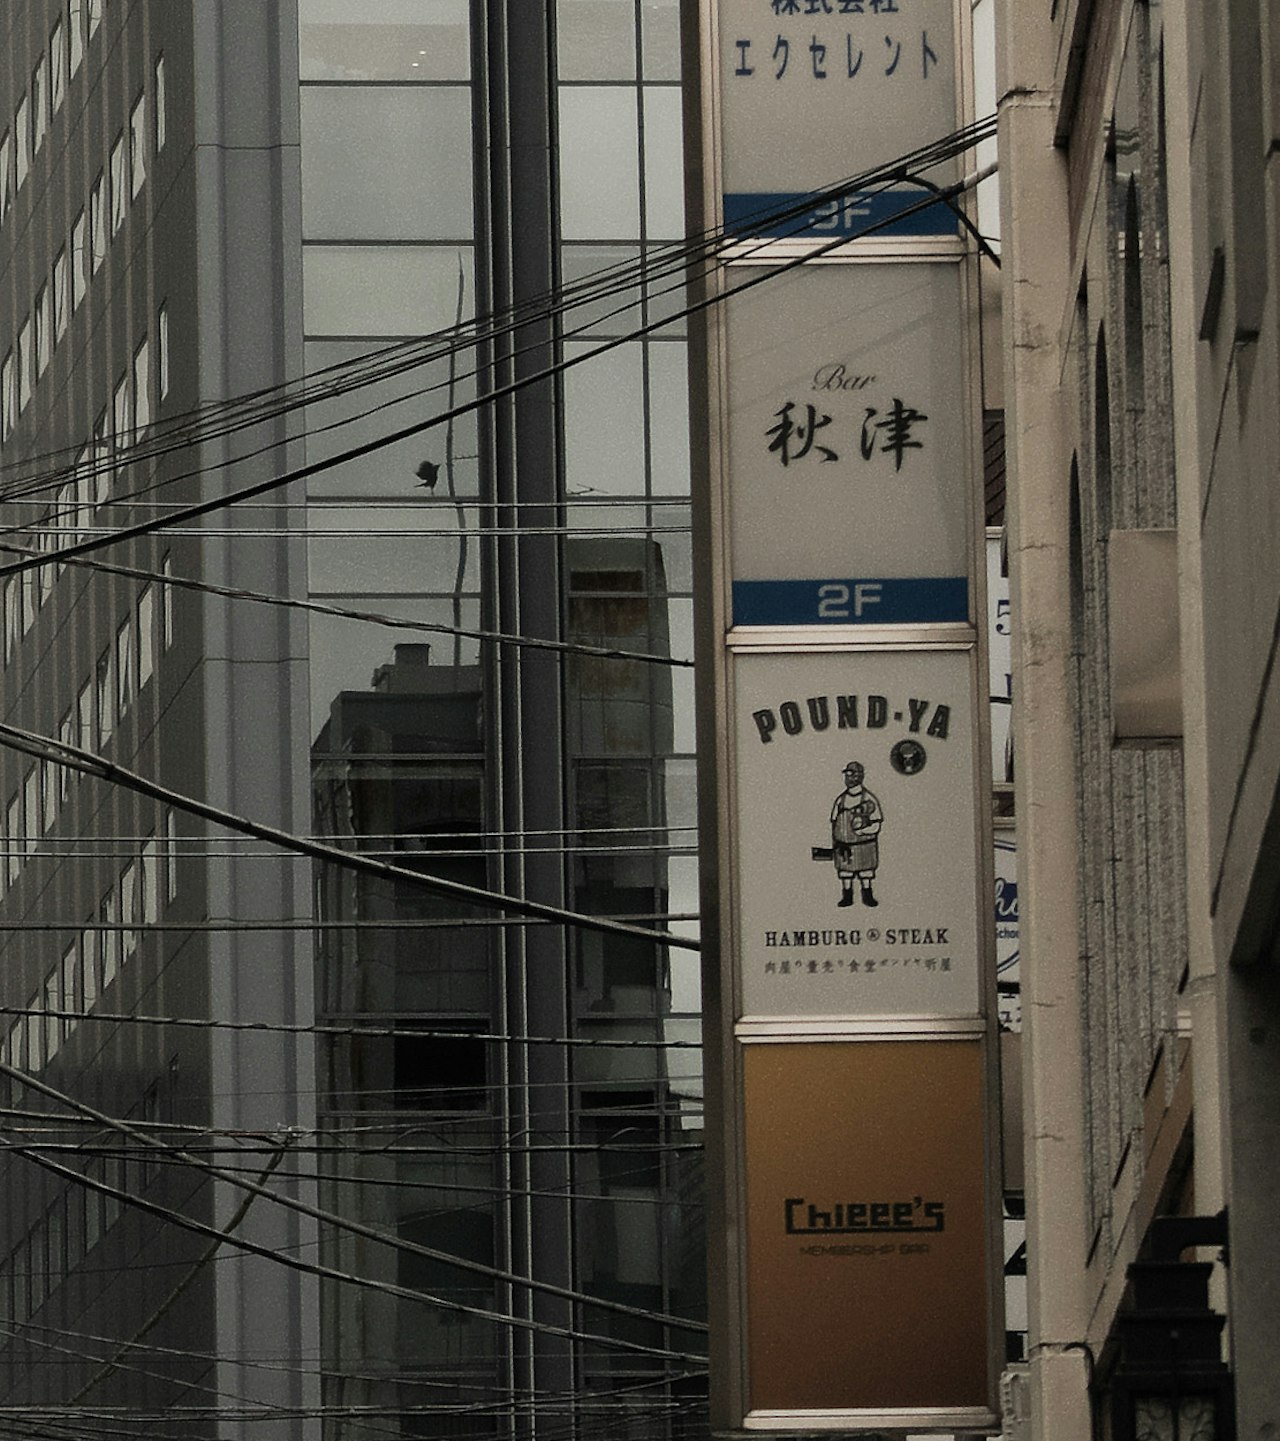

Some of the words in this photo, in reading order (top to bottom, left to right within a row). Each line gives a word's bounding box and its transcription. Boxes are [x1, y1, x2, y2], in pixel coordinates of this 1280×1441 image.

[734, 30, 938, 80] エクセレント
[811, 364, 877, 391] Bar
[764, 398, 929, 473] 秋津
[817, 583, 883, 618] 2F
[765, 930, 861, 947] HAMBURG
[885, 927, 949, 945] STEAK
